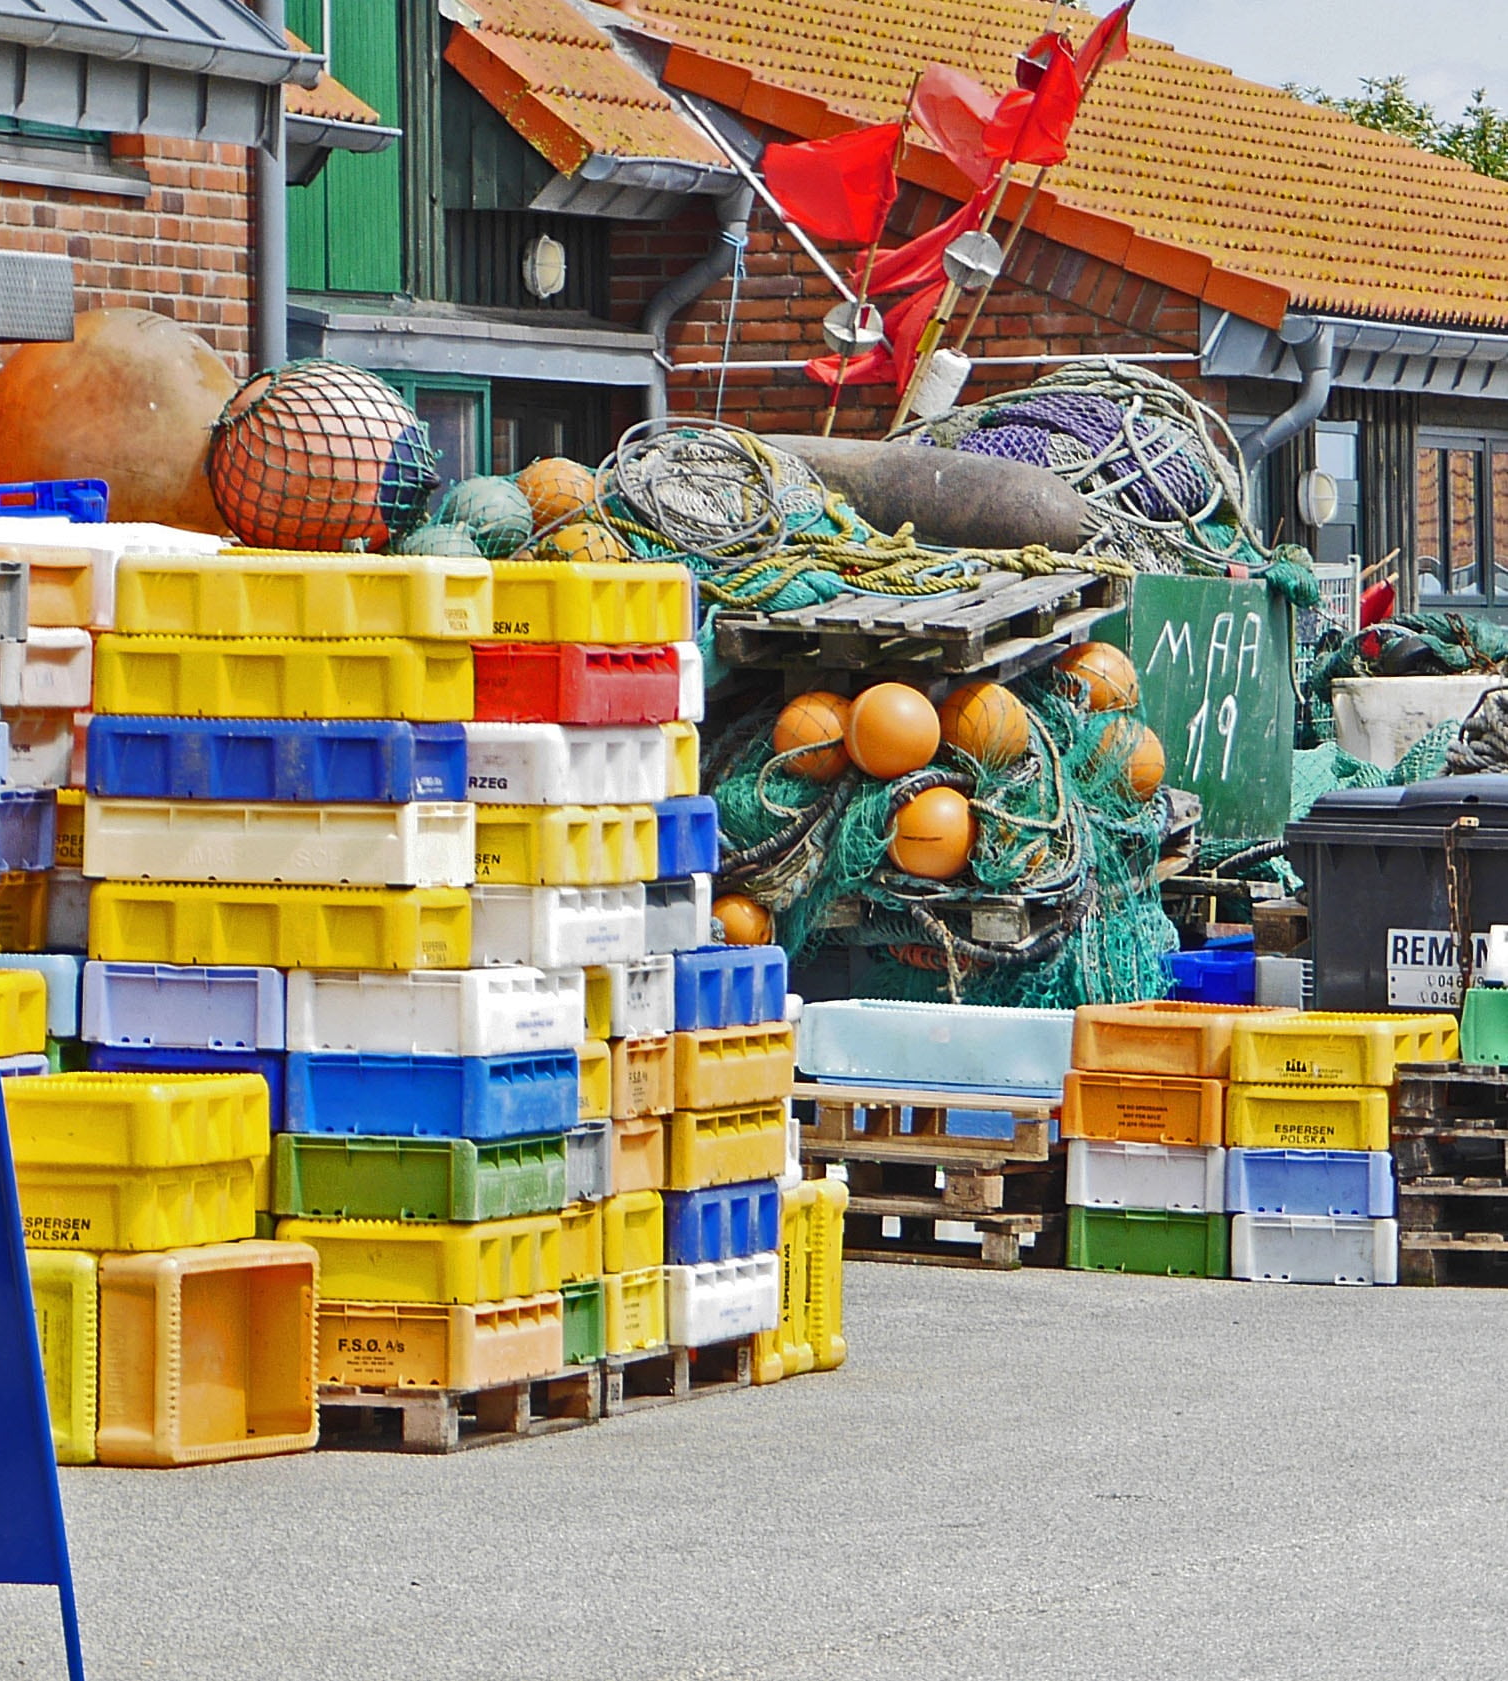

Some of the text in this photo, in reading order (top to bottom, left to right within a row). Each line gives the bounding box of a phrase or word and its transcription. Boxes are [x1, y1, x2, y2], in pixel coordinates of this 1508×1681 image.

[492, 622, 530, 634] SEN A/S
[469, 776, 509, 790] RZEG
[1391, 934, 1489, 969] REMN
[1274, 1124, 1335, 1136] ESPERSEN
[1280, 1134, 1327, 1145] POLSKA
[22, 1216, 91, 1230] SPERSEN
